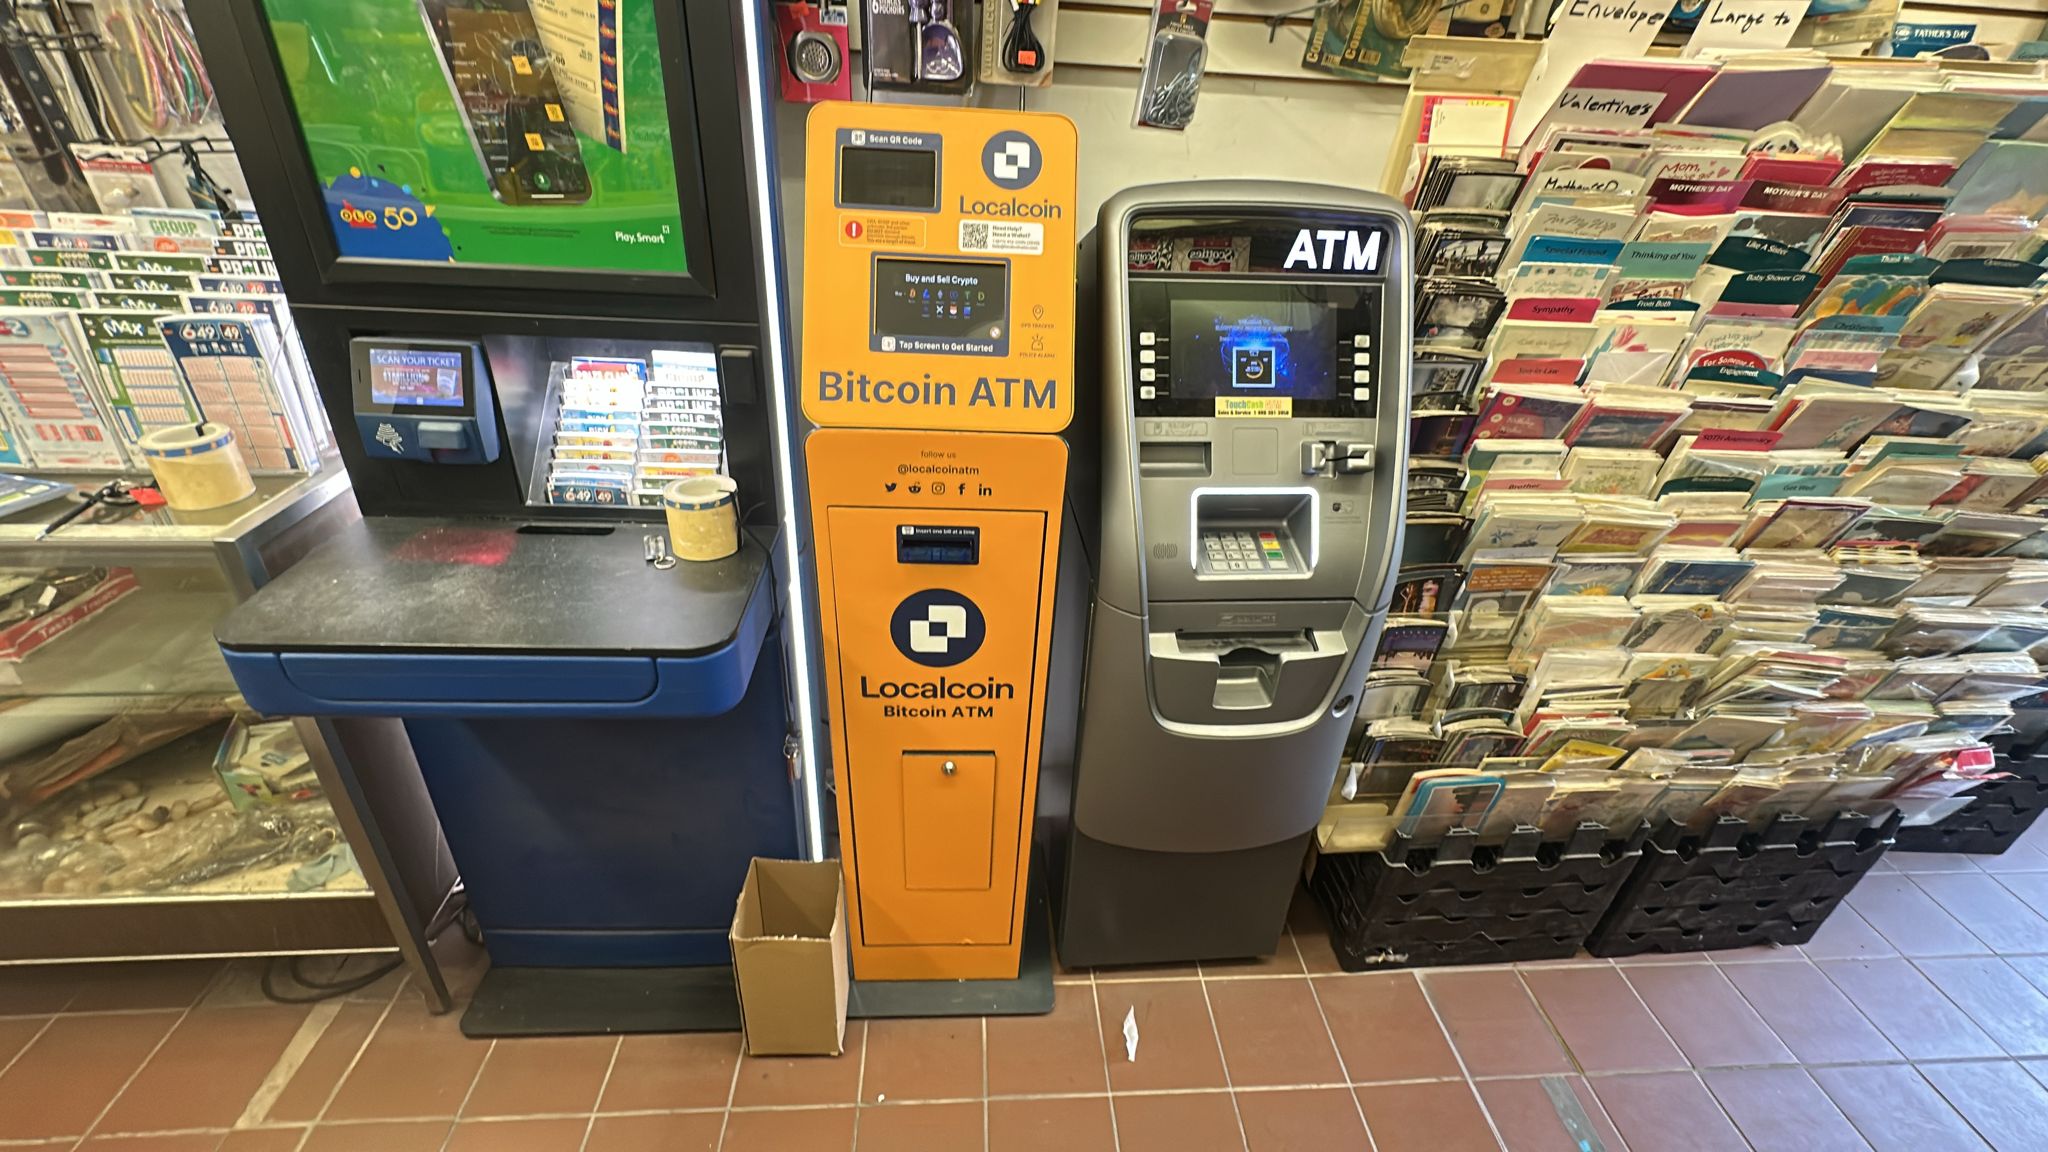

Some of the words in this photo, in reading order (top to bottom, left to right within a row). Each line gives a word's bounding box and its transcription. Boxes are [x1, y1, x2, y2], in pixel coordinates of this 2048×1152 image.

[1569, 0, 1666, 32] Envelope
[1710, 1, 1764, 34] Large
[1953, 30, 1971, 39] DAY
[869, 134, 889, 144] Scan
[890, 135, 901, 145] QR
[902, 136, 923, 146] Code
[1669, 183, 1715, 193] MOTHER'S
[1716, 185, 1735, 193] DAY
[1763, 187, 1810, 198] MOTHER'S
[1811, 191, 1829, 200] DAY
[960, 195, 1062, 219] Localcoin
[384, 206, 418, 231] 50
[149, 219, 197, 236] GROUP
[1283, 228, 1382, 271] ATM
[1631, 251, 1669, 261] Thinking
[1670, 252, 1681, 261] of
[1681, 253, 1697, 261] You
[905, 273, 920, 284] Buy
[921, 274, 936, 283] and
[936, 275, 950, 284] Sell
[951, 276, 979, 287] Crypto
[1746, 273, 1765, 283] Baby
[1765, 274, 1791, 282] Shower
[1792, 274, 1806, 282] Gift
[1637, 299, 1655, 307] From
[1532, 305, 1576, 315] Sympathy
[101, 318, 145, 337] MAX
[899, 340, 913, 350] Tap
[914, 340, 941, 351] Screen
[941, 341, 950, 351] to
[950, 342, 965, 352] Get
[965, 343, 994, 353] Started
[376, 355, 400, 365] SCAN
[400, 356, 426, 366] YOUR
[427, 356, 456, 367] TICKET
[818, 370, 956, 406] Bitcoin
[968, 376, 1057, 410] ATM
[920, 450, 945, 459] follow
[946, 452, 957, 460] us
[897, 464, 980, 476] @localcoinatm
[860, 675, 1014, 700] Localcoin
[883, 705, 946, 718] Bitcoin
[951, 706, 994, 719] ATM
